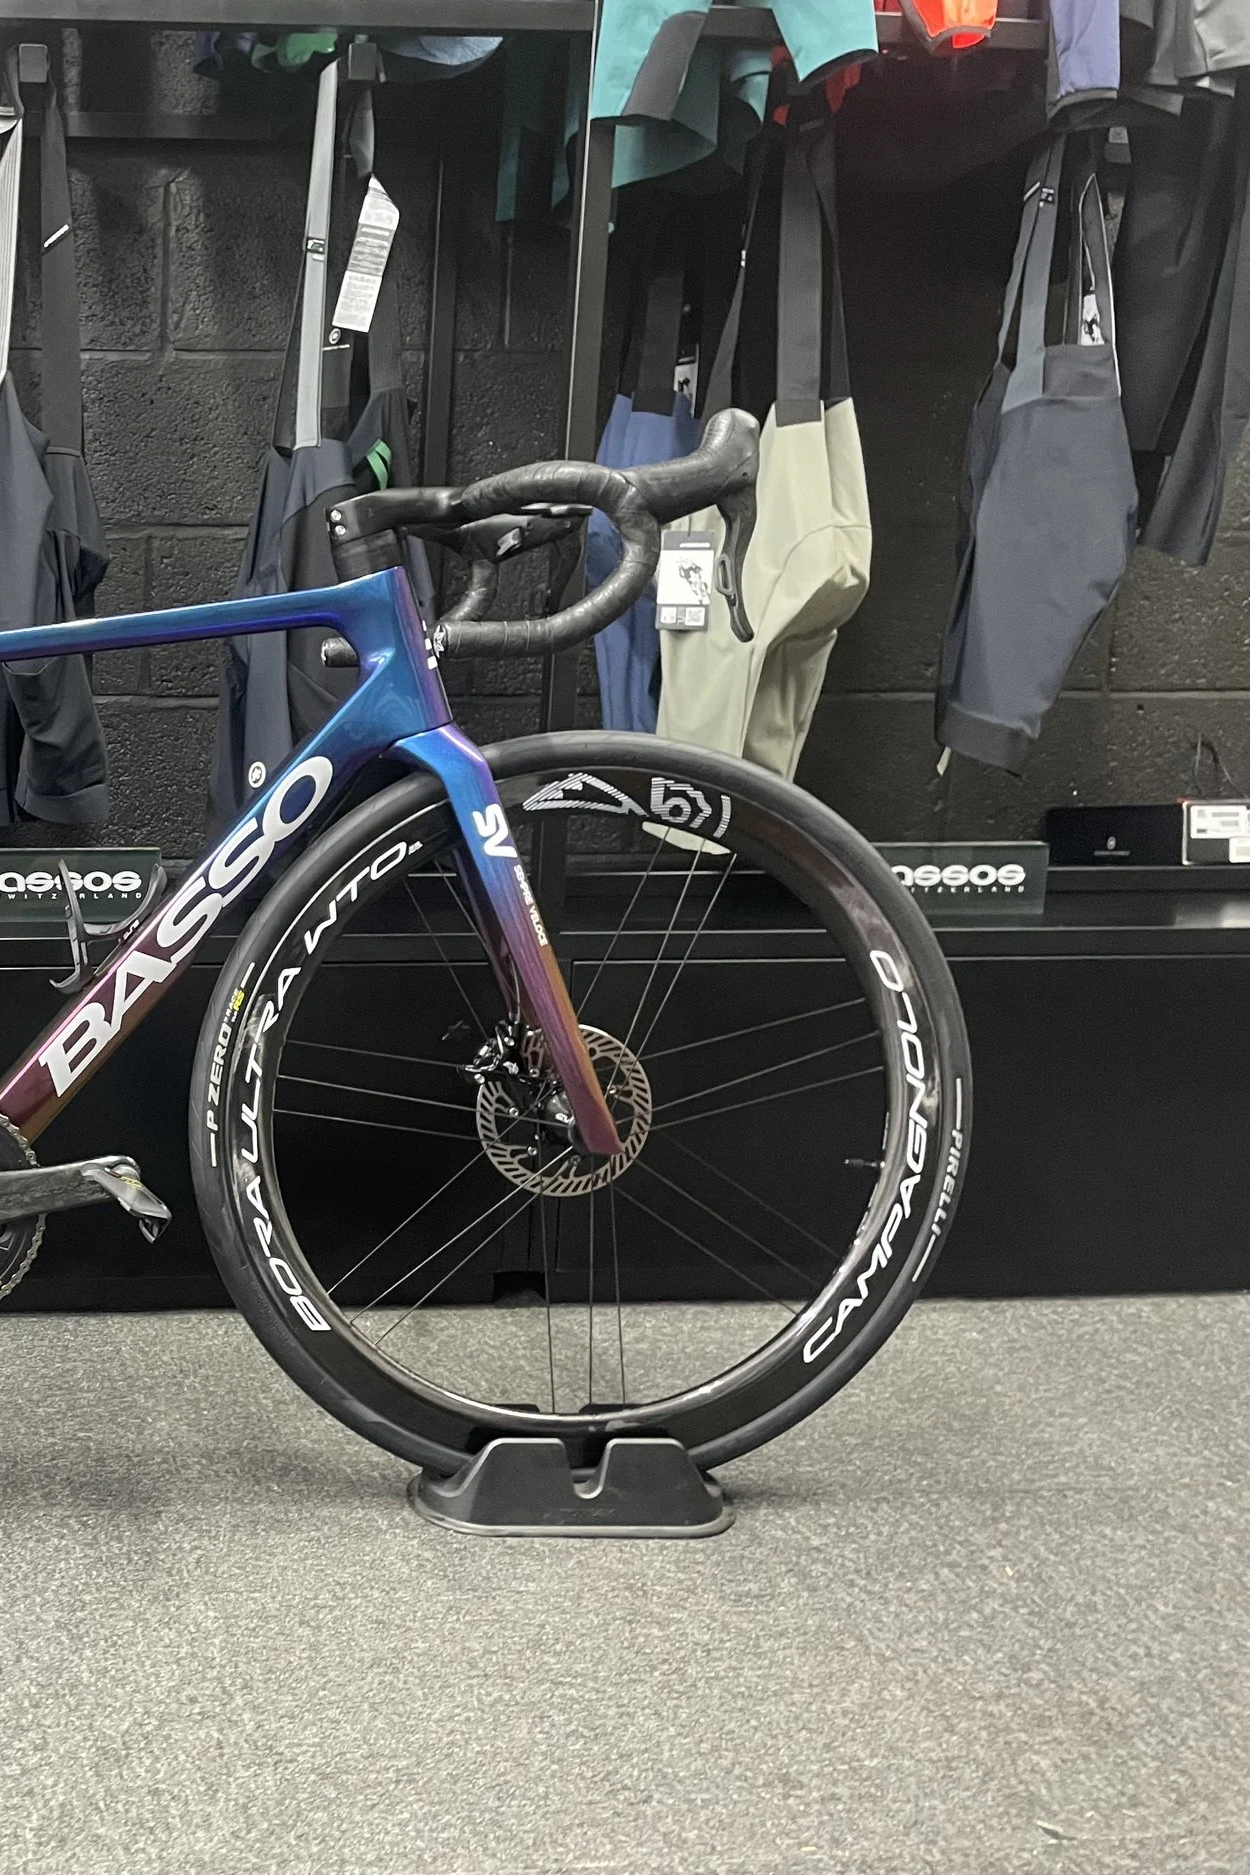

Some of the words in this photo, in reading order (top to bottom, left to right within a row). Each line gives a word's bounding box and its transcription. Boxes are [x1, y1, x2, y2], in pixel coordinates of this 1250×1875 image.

[39, 756, 333, 1097] BASSO
[304, 841, 407, 955] WTO
[529, 905, 549, 947] VELOCE
[207, 1109, 218, 1131] P
[208, 1022, 232, 1106] ZERO
[241, 967, 302, 1163] ULTRA
[803, 950, 928, 1363] CAMPAGNOLO
[931, 1128, 963, 1237] PIRELLI
[246, 1175, 331, 1331] BORA
